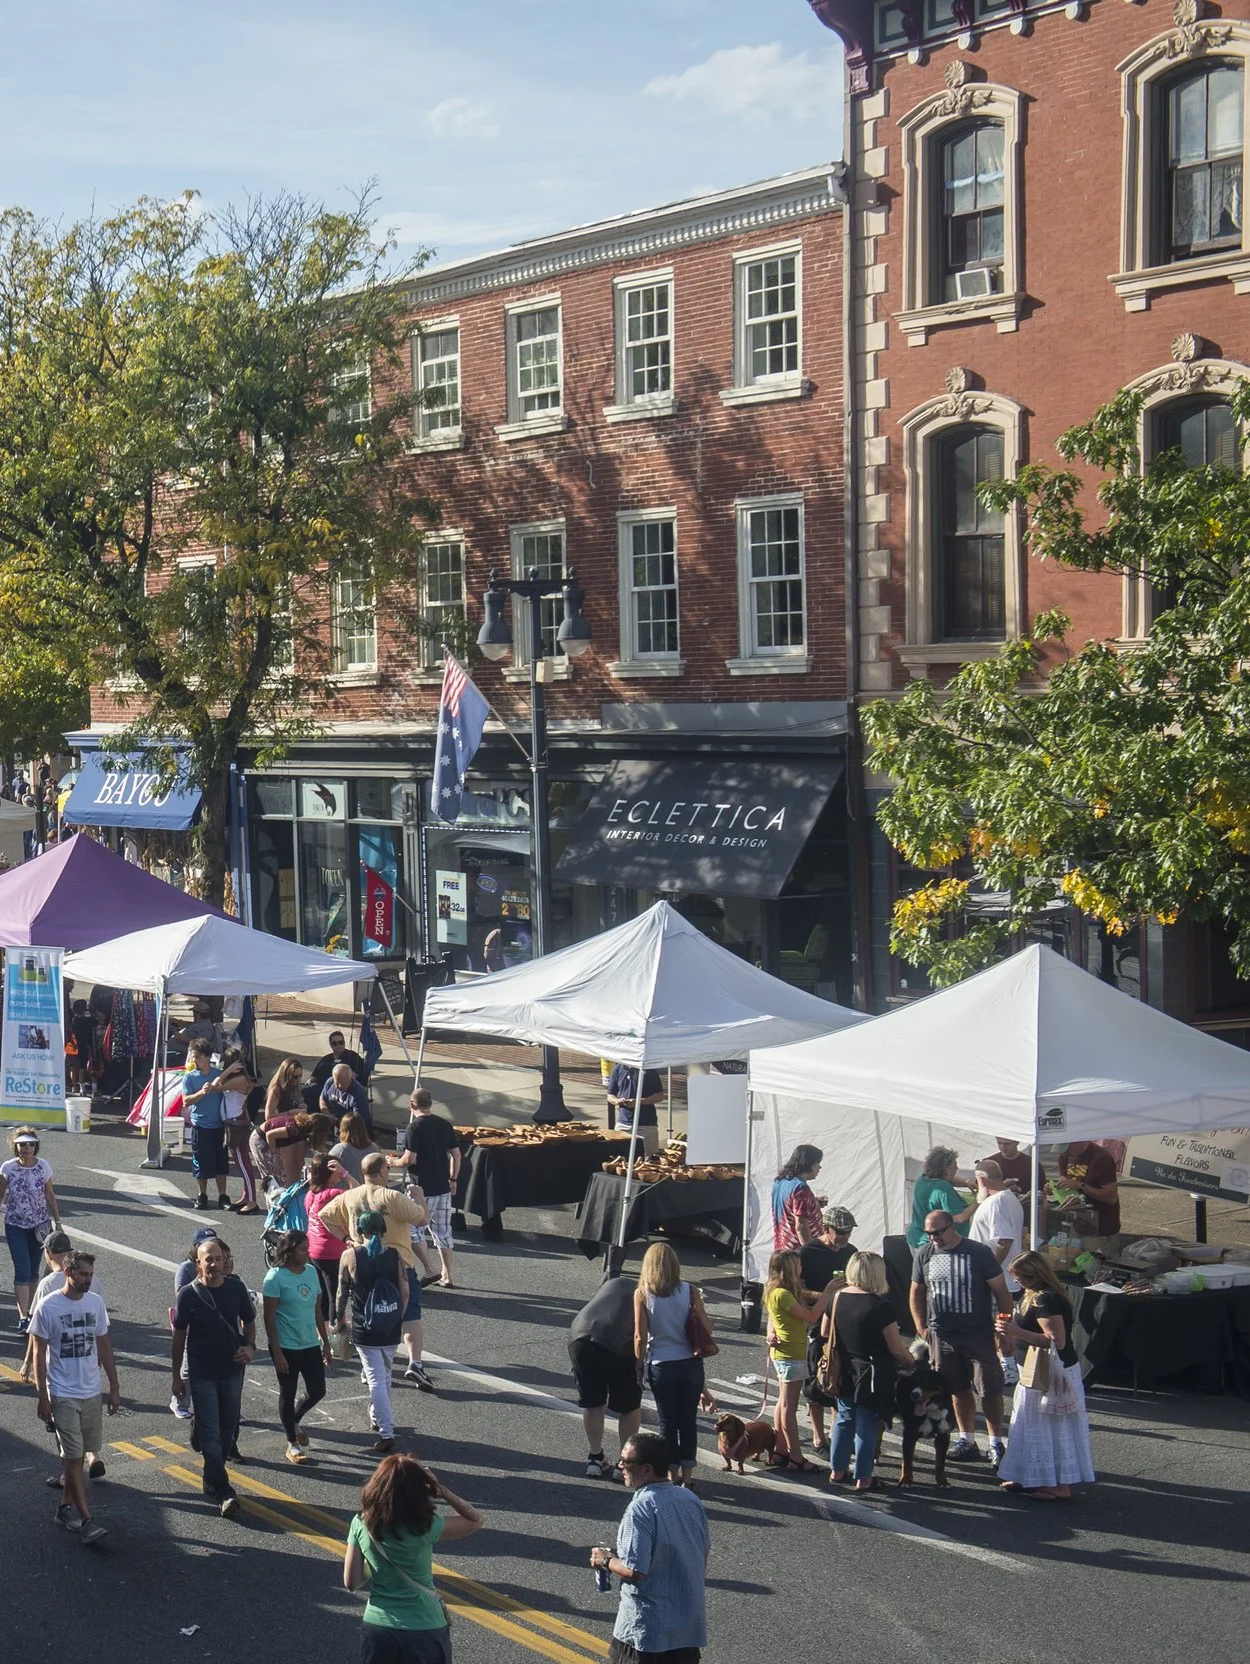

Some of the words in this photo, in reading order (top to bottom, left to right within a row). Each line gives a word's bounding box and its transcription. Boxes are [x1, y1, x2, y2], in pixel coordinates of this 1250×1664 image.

[607, 800, 786, 831] ECLETTICA
[606, 830, 660, 841] INTERIOR
[665, 833, 704, 844] DECOR
[710, 837, 716, 845] &
[722, 838, 767, 848] DESIGN
[321, 867, 344, 886] TOKEN
[443, 881, 460, 890] FREE
[375, 900, 384, 935] OPEN
[6, 1077, 61, 1095] ReStore
[1160, 1136, 1176, 1147] FUN
[1177, 1140, 1187, 1149] &
